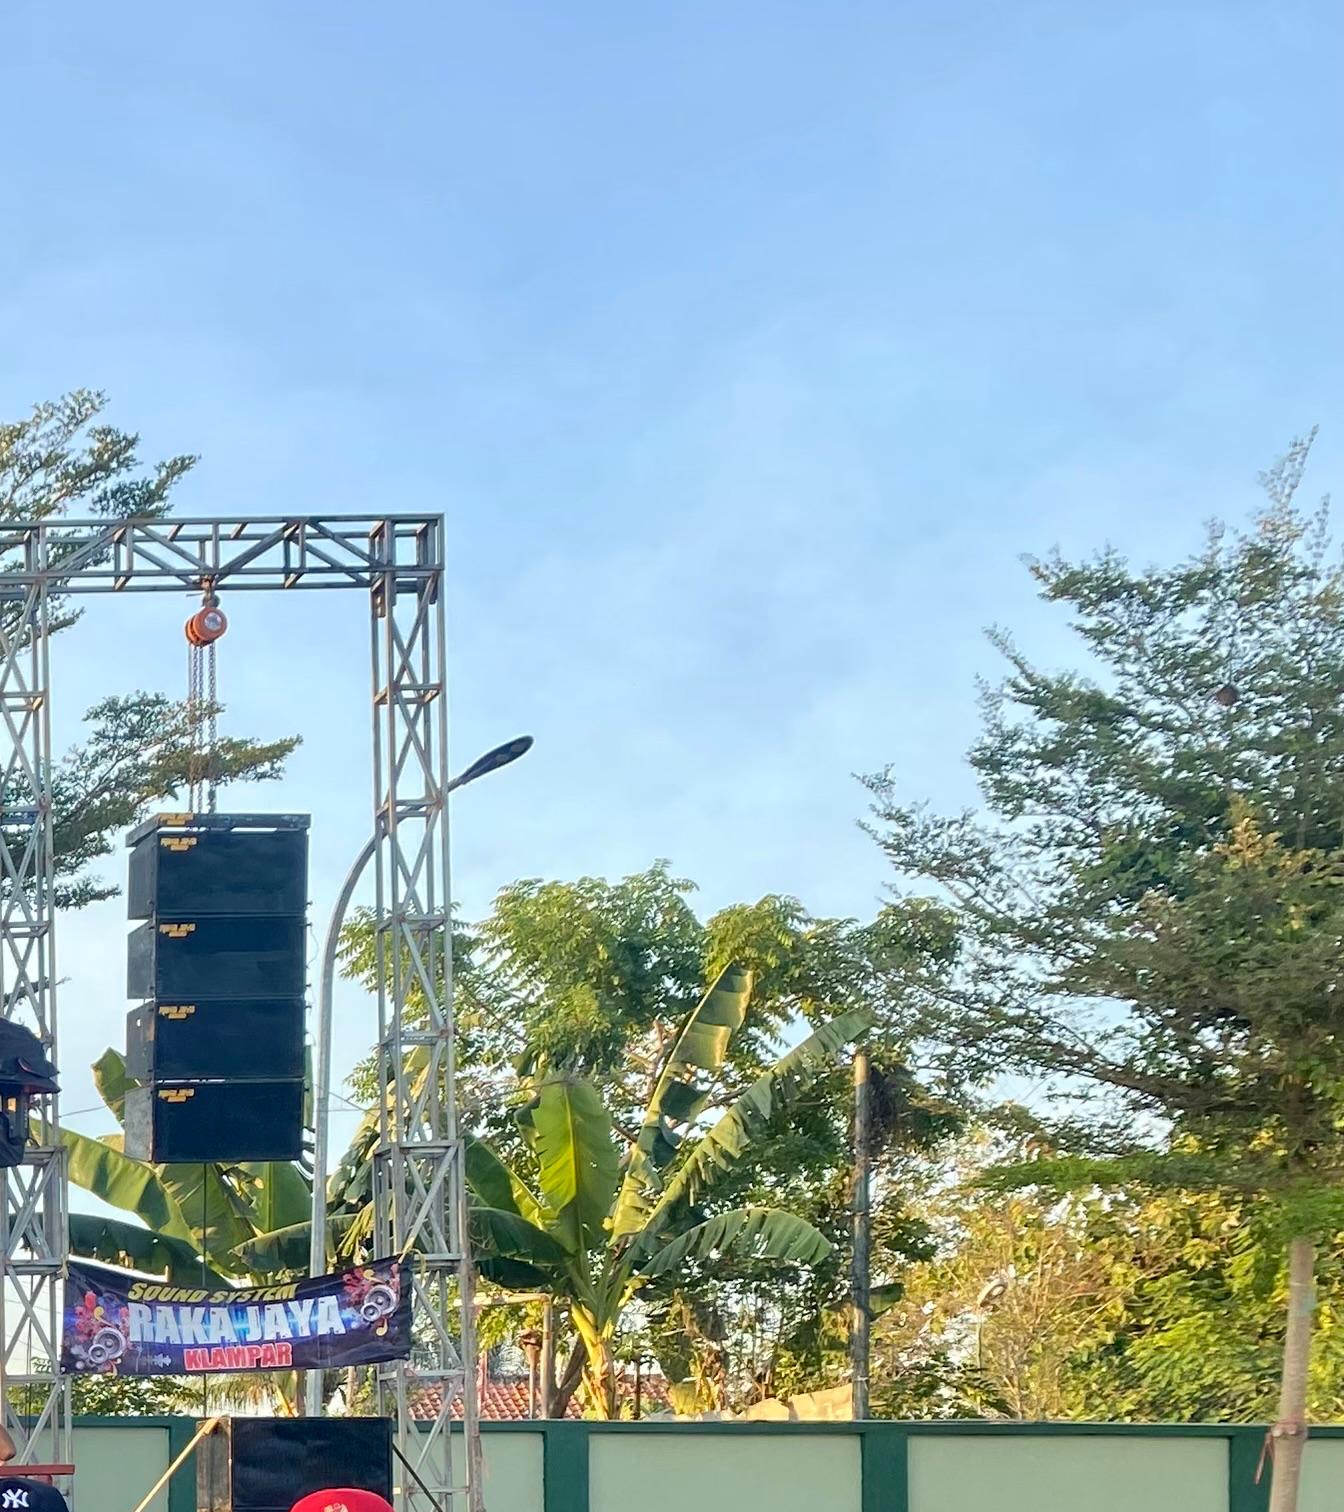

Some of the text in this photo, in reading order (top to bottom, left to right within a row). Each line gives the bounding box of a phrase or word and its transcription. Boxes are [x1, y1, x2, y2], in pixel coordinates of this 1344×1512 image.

[128, 1282, 299, 1304] SOUND SYSTEM
[128, 1295, 347, 1345] RAKA JAYA
[184, 1342, 293, 1371] KLAMPAR
